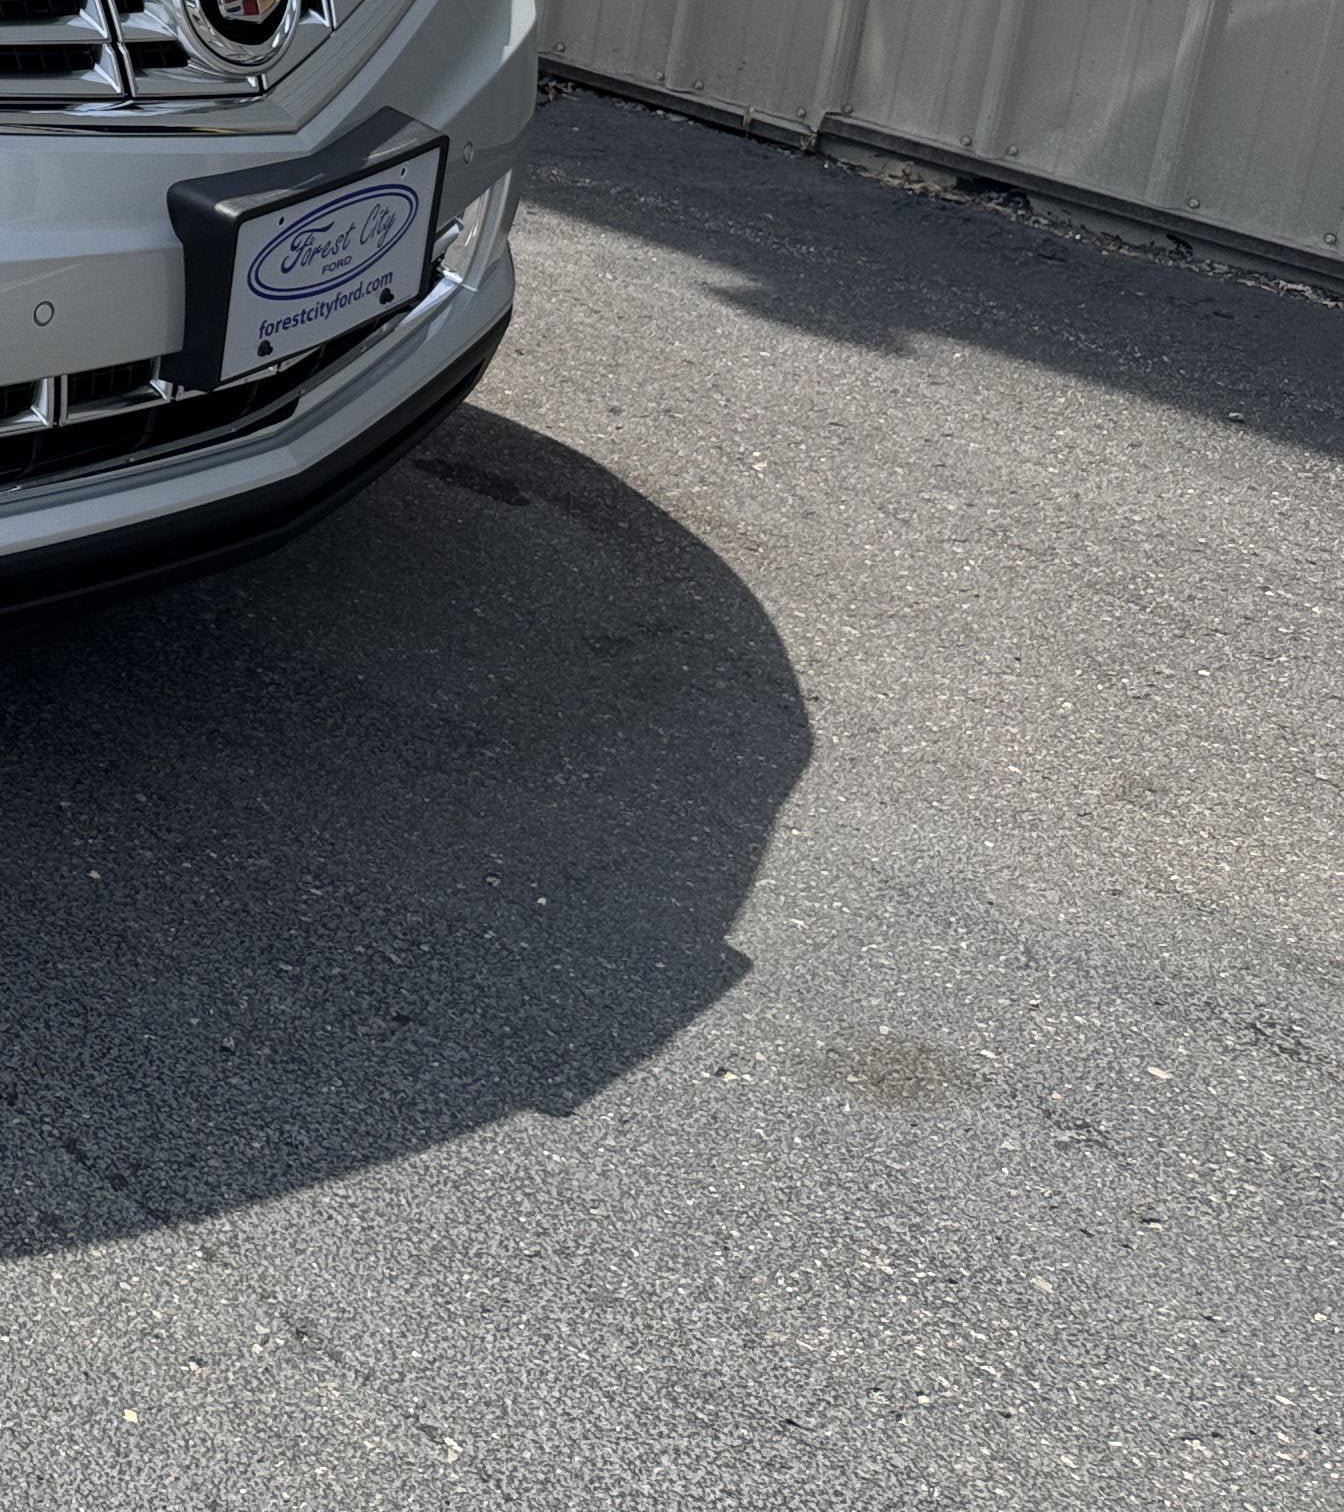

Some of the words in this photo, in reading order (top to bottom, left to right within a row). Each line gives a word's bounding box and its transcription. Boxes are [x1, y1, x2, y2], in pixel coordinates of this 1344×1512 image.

[280, 220, 355, 275] Forest
[359, 202, 396, 250] City
[322, 255, 353, 275] FORD
[258, 271, 394, 339] forestcityford.com
